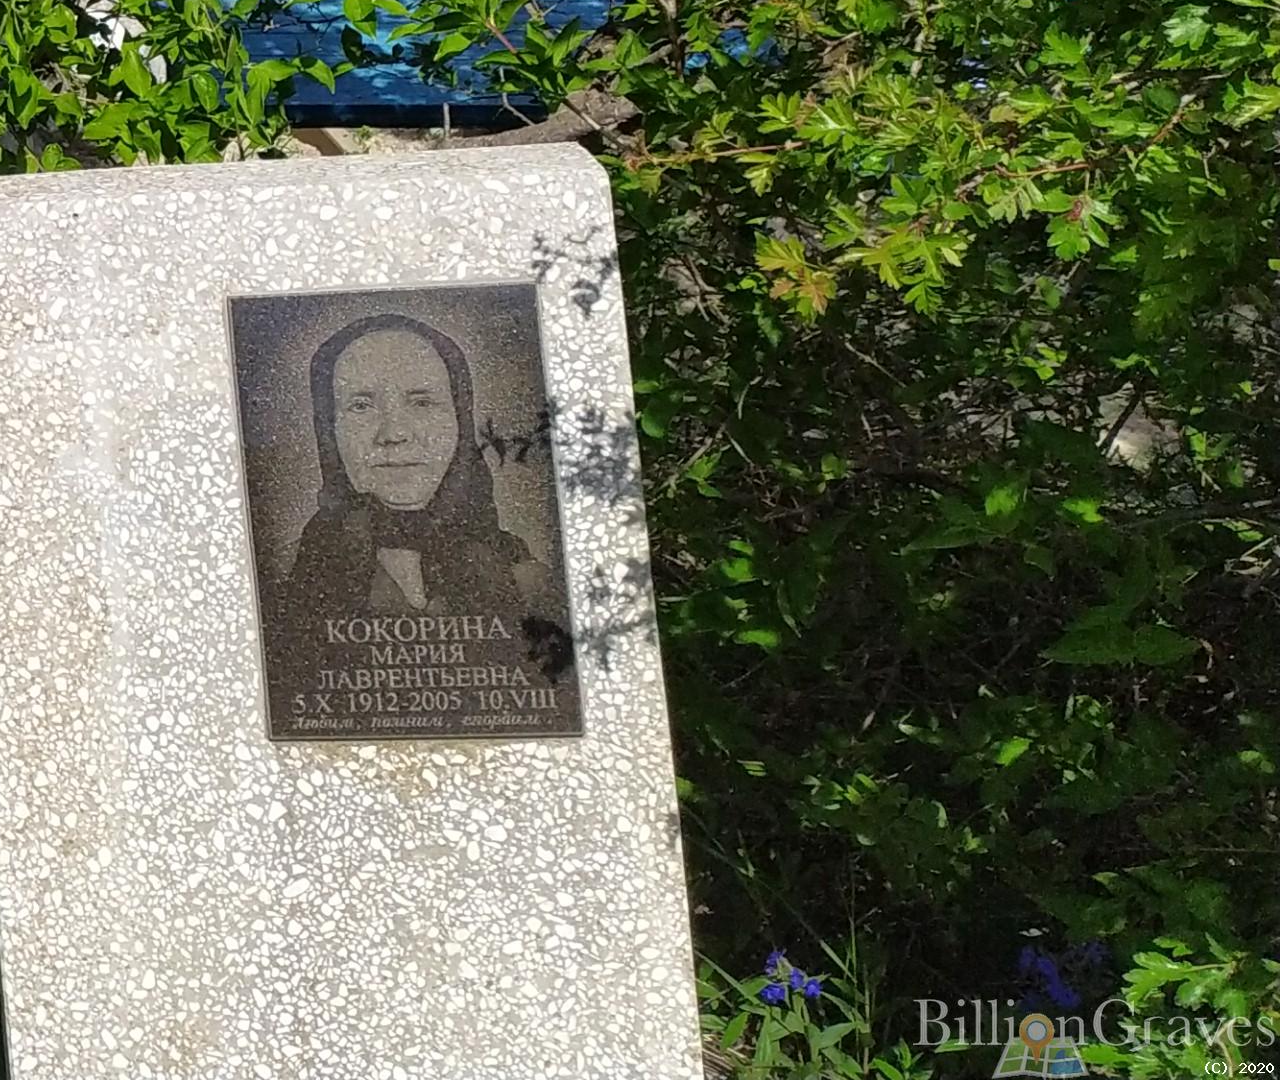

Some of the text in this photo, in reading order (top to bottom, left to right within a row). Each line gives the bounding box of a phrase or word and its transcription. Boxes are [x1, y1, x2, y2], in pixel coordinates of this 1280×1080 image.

[324, 614, 512, 644] КОКОРИНА
[369, 643, 467, 666] МАРИЯ
[318, 664, 531, 691] ЛАВРЕНТЬЕВНА
[347, 689, 463, 713] 1912-2005
